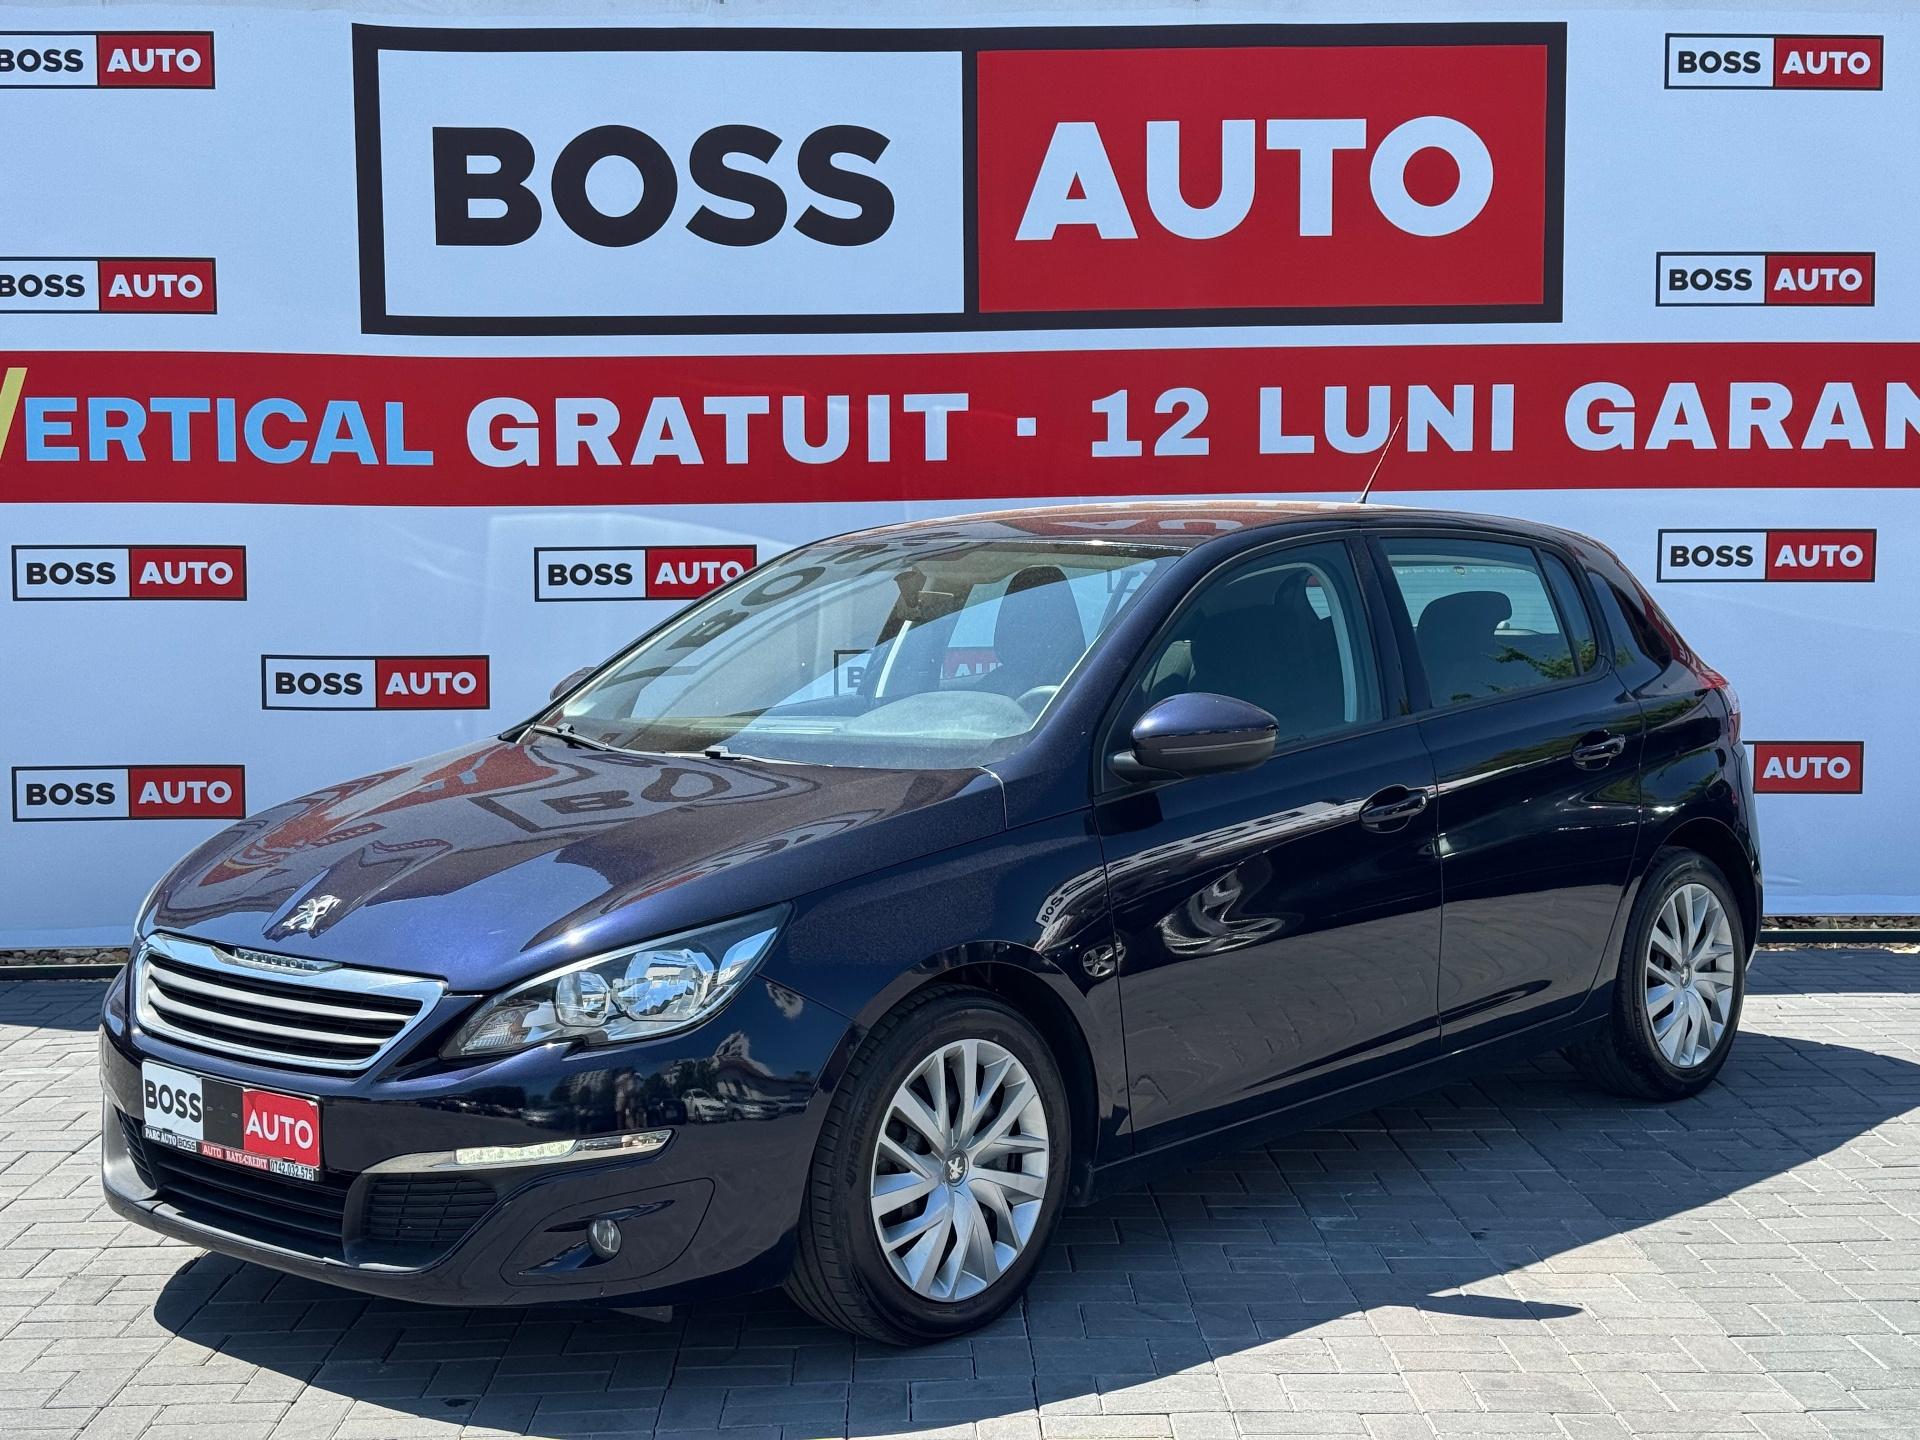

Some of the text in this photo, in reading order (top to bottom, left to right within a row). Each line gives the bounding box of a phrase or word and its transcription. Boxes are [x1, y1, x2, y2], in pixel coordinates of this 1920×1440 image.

[0, 48, 202, 73] BOSS AUTO
[1677, 50, 1871, 75] BOSS AUTO
[432, 116, 1493, 247] BOSS AUTO
[0, 273, 203, 299] BOSS AUTO
[1668, 267, 1863, 292] BOSS AUTO
[466, 393, 969, 468] GRATUIT
[1091, 387, 1210, 458] 12
[1259, 383, 1515, 455] LUNI
[1670, 544, 1864, 568] BOSS AUTO
[26, 561, 234, 586] BOSS AUTO
[547, 561, 745, 586] BOSS AUTO
[275, 671, 477, 696] BOSS AUTO
[1762, 756, 1851, 780] AUTO
[26, 781, 233, 806] BOSS AUTO
[243, 951, 308, 970] PEUGEOT
[144, 1079, 314, 1150] BOSS AUTO
[161, 1132, 177, 1146] AUTO
[178, 1138, 196, 1151] BOSS
[203, 1145, 222, 1158] AUTO
